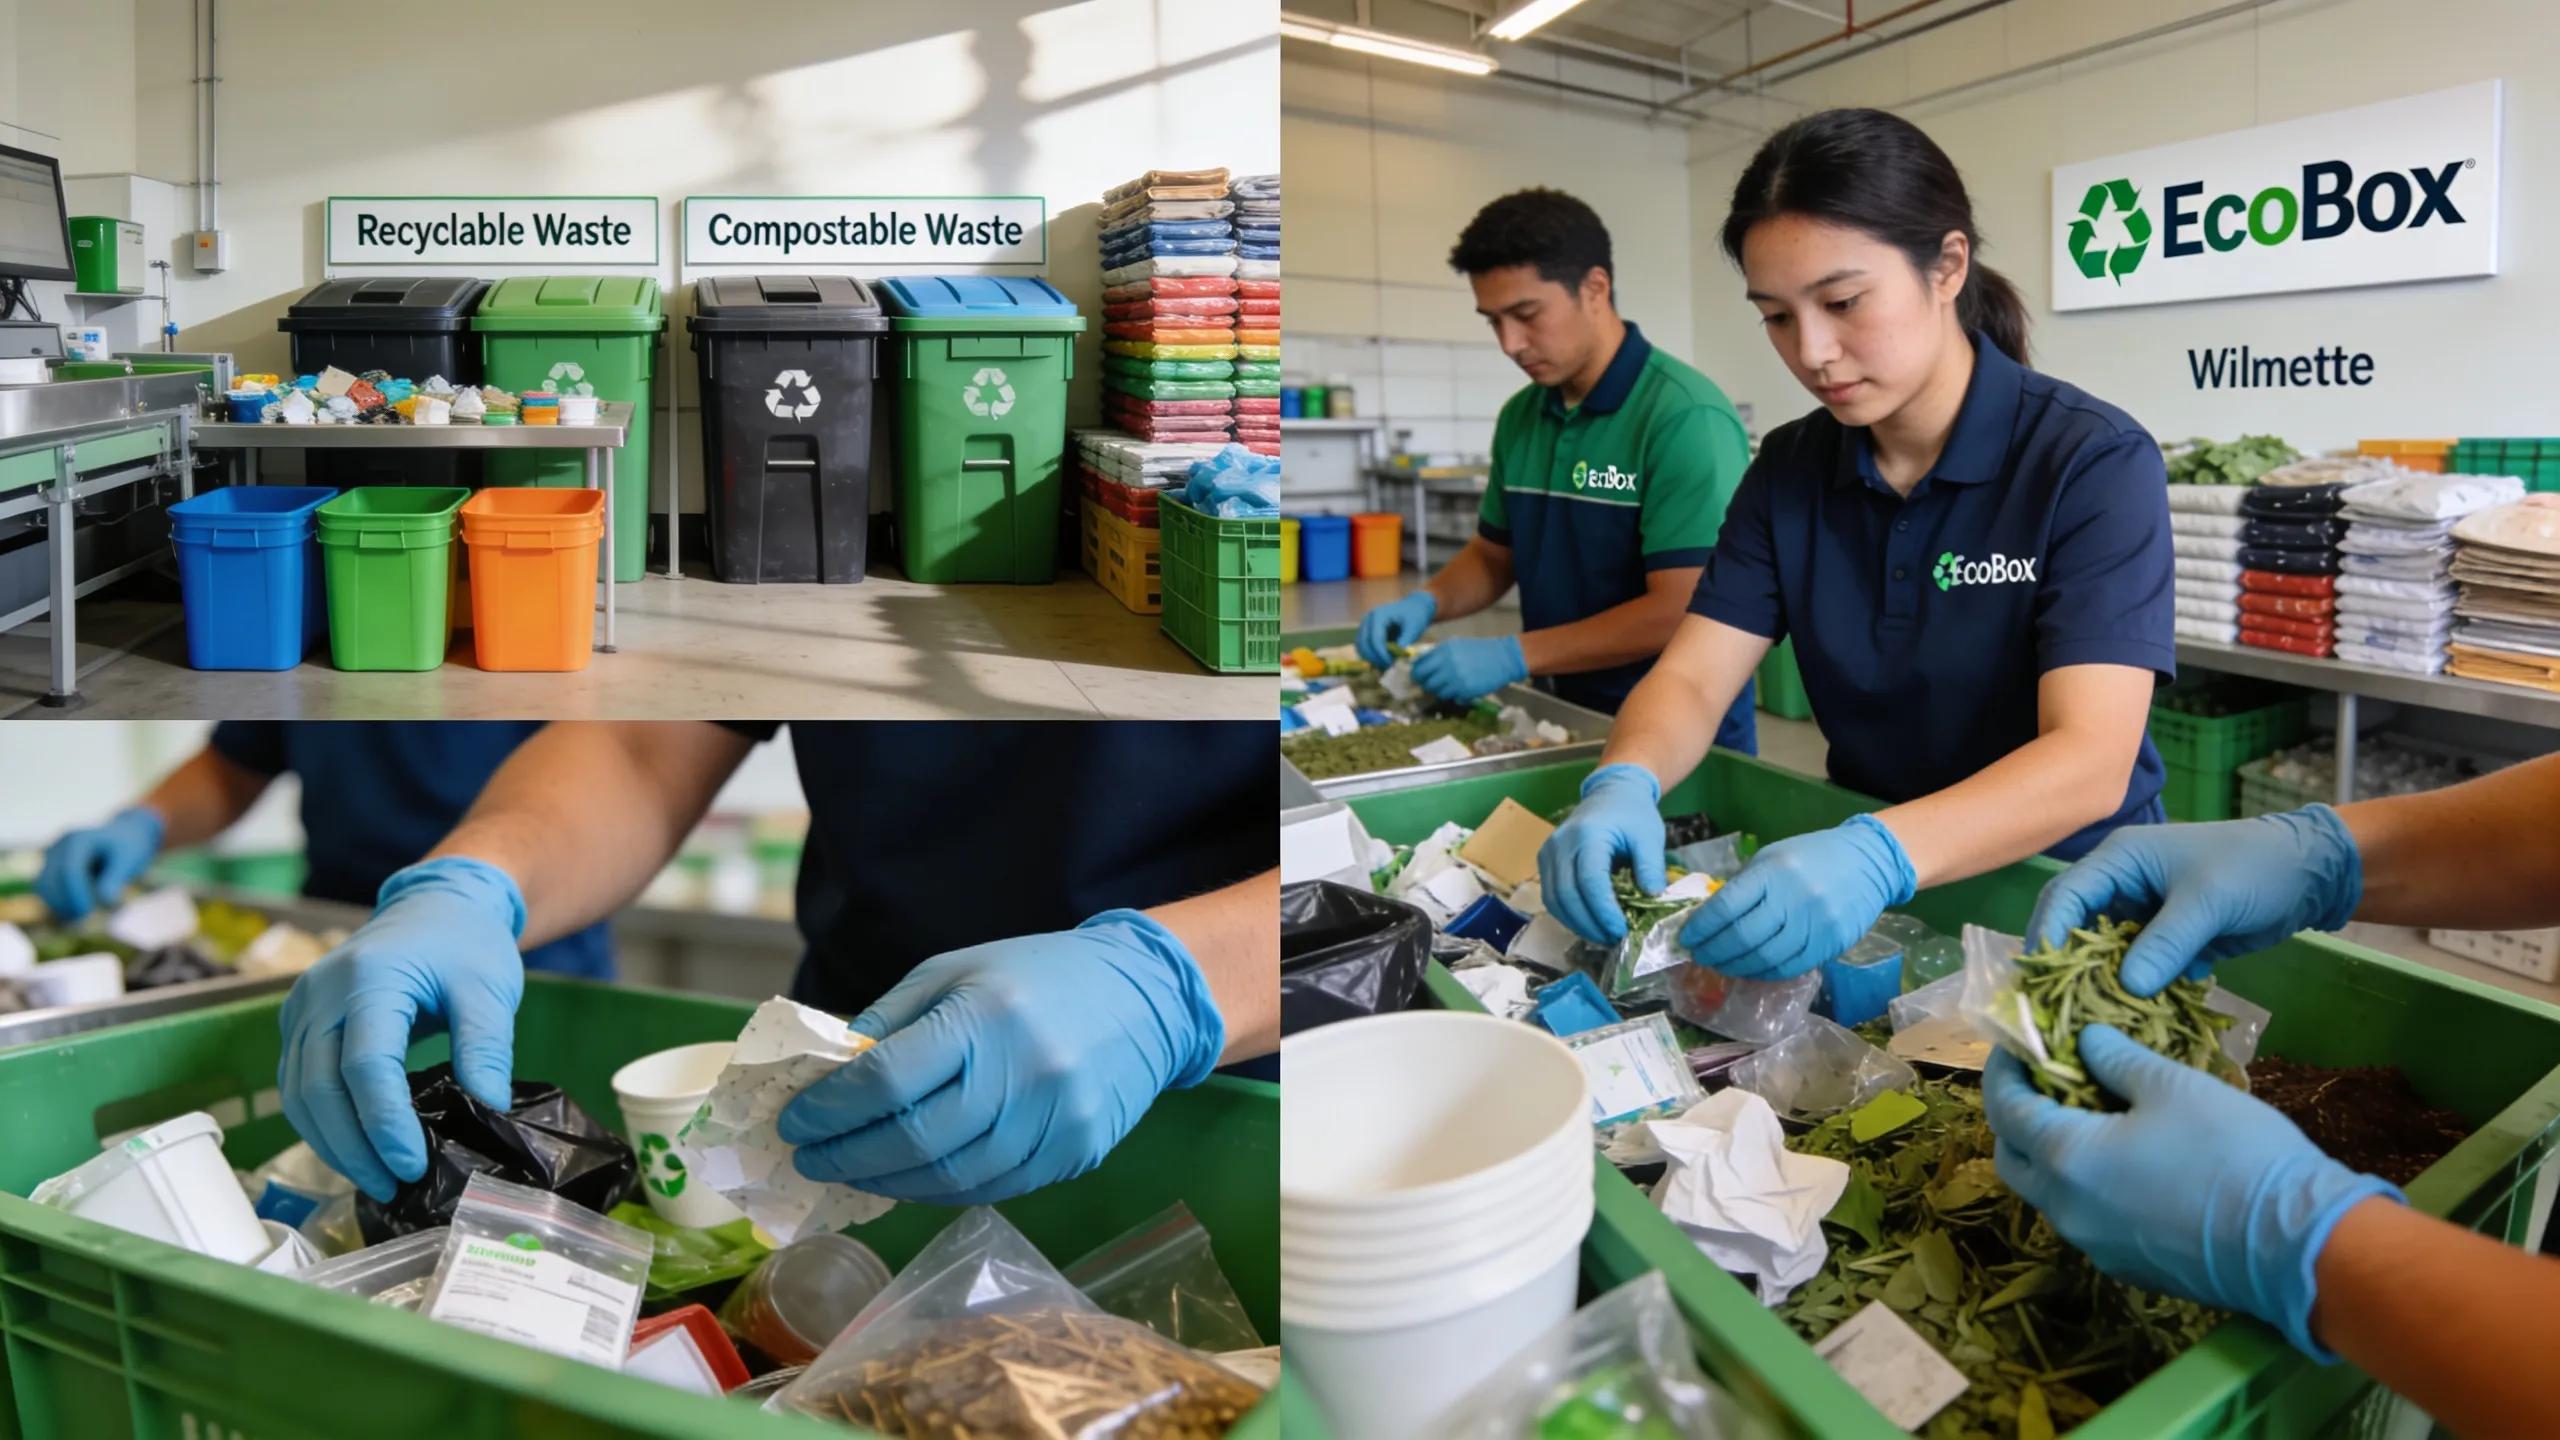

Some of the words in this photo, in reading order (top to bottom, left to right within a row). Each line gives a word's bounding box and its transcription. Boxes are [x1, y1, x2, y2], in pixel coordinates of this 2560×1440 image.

[2163, 159, 2466, 258] EcoBox
[357, 211, 525, 255] Recyclable
[532, 212, 632, 246] Waste
[708, 211, 917, 254] Compostable
[924, 212, 1024, 246] Waste
[2187, 345, 2375, 390] Wilmette
